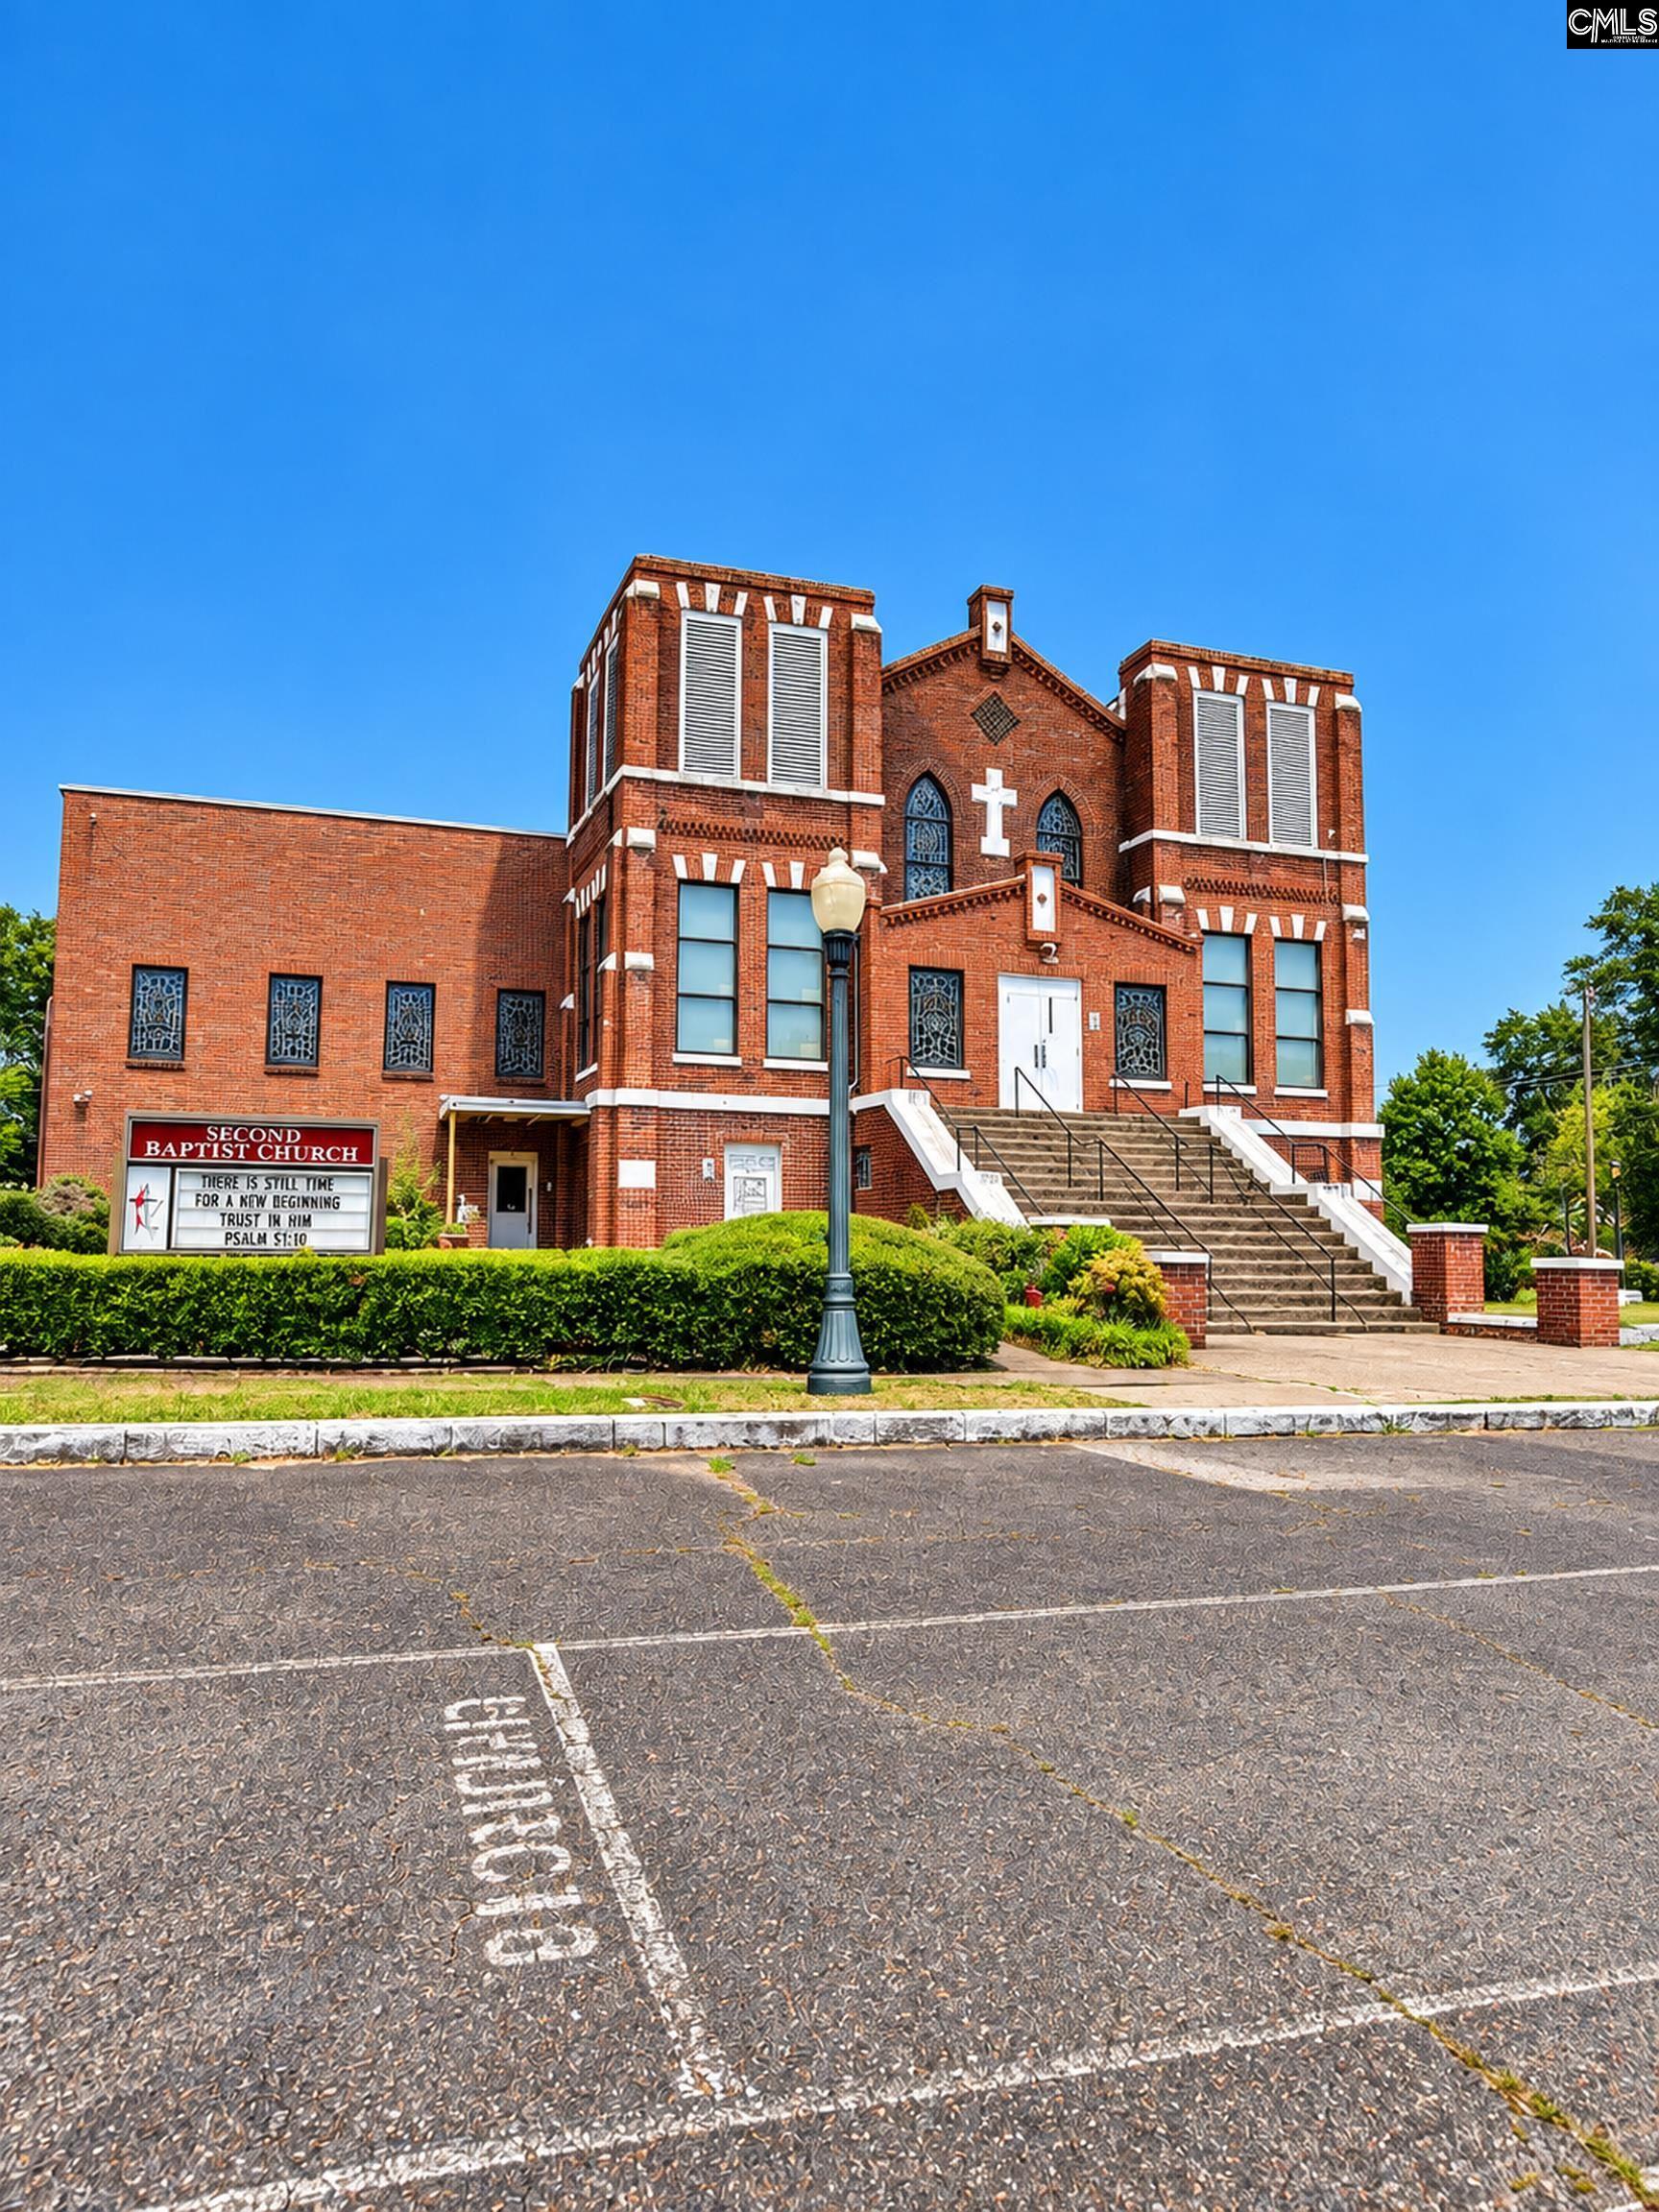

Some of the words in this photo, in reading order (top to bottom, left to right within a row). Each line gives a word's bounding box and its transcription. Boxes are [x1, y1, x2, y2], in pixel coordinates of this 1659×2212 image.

[206, 1125, 301, 1143] SECOND
[145, 1141, 251, 1159] BAPTIST
[257, 1143, 358, 1162] CHURCH
[202, 1174, 239, 1190] THERE
[246, 1175, 258, 1190] IS
[264, 1176, 299, 1190] STILL
[306, 1177, 335, 1191] TIME
[195, 1192, 219, 1208] FOR
[226, 1193, 233, 1208] A
[273, 1194, 341, 1210] BEGINNING
[220, 1213, 261, 1228] TRUST
[268, 1214, 281, 1228] IN
[225, 1231, 267, 1246] PSALM
